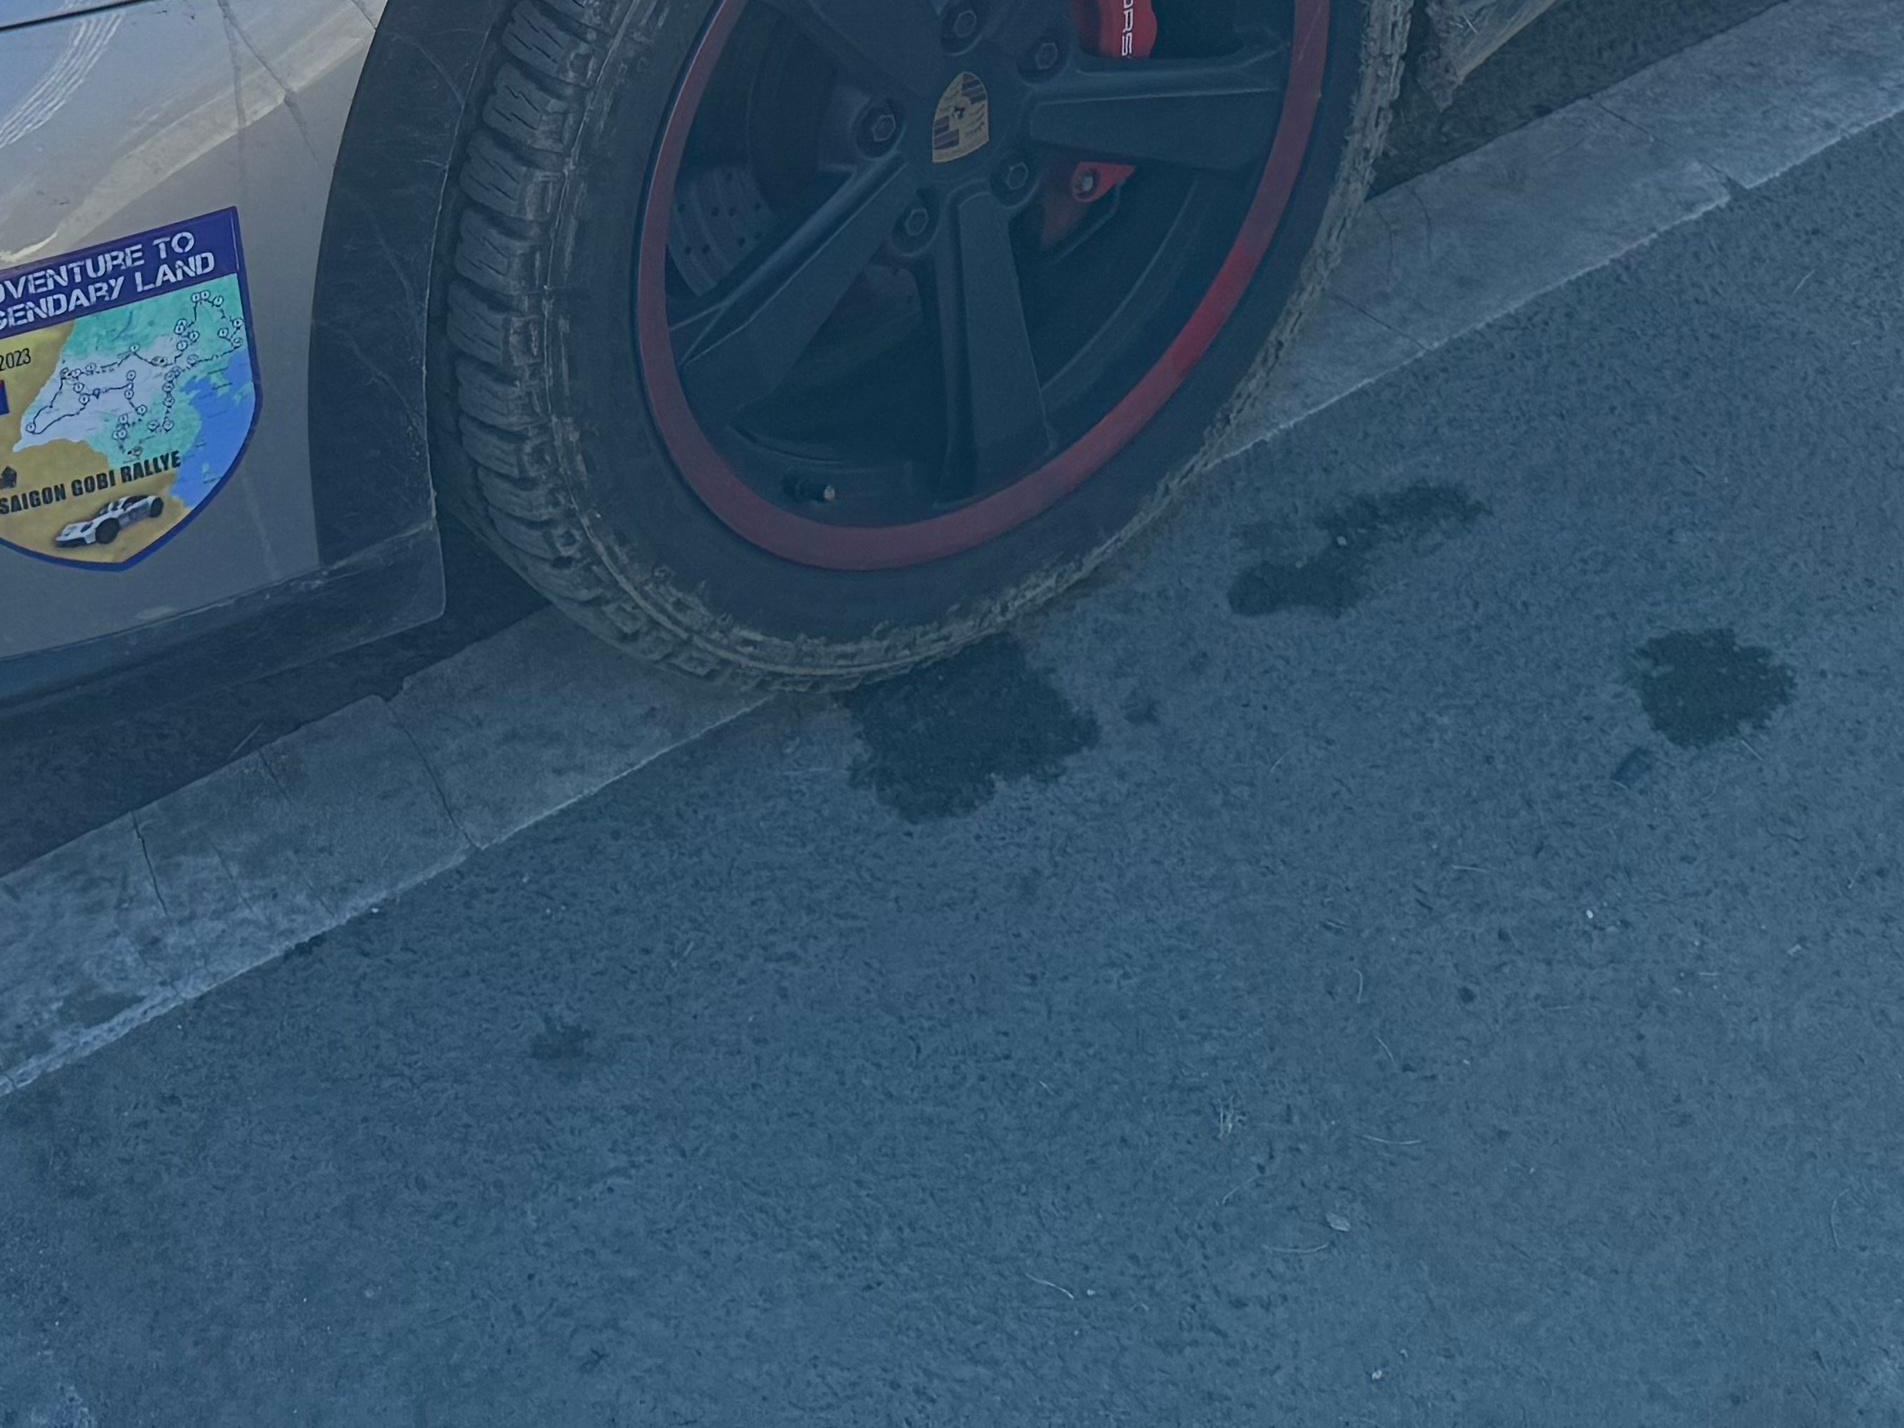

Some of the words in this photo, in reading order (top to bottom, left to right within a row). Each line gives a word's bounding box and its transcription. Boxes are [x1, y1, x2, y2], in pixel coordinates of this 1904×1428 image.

[152, 231, 195, 261] TO
[135, 252, 216, 293] LAND
[71, 469, 117, 497] GOBI
[120, 450, 182, 483] RALLYE
